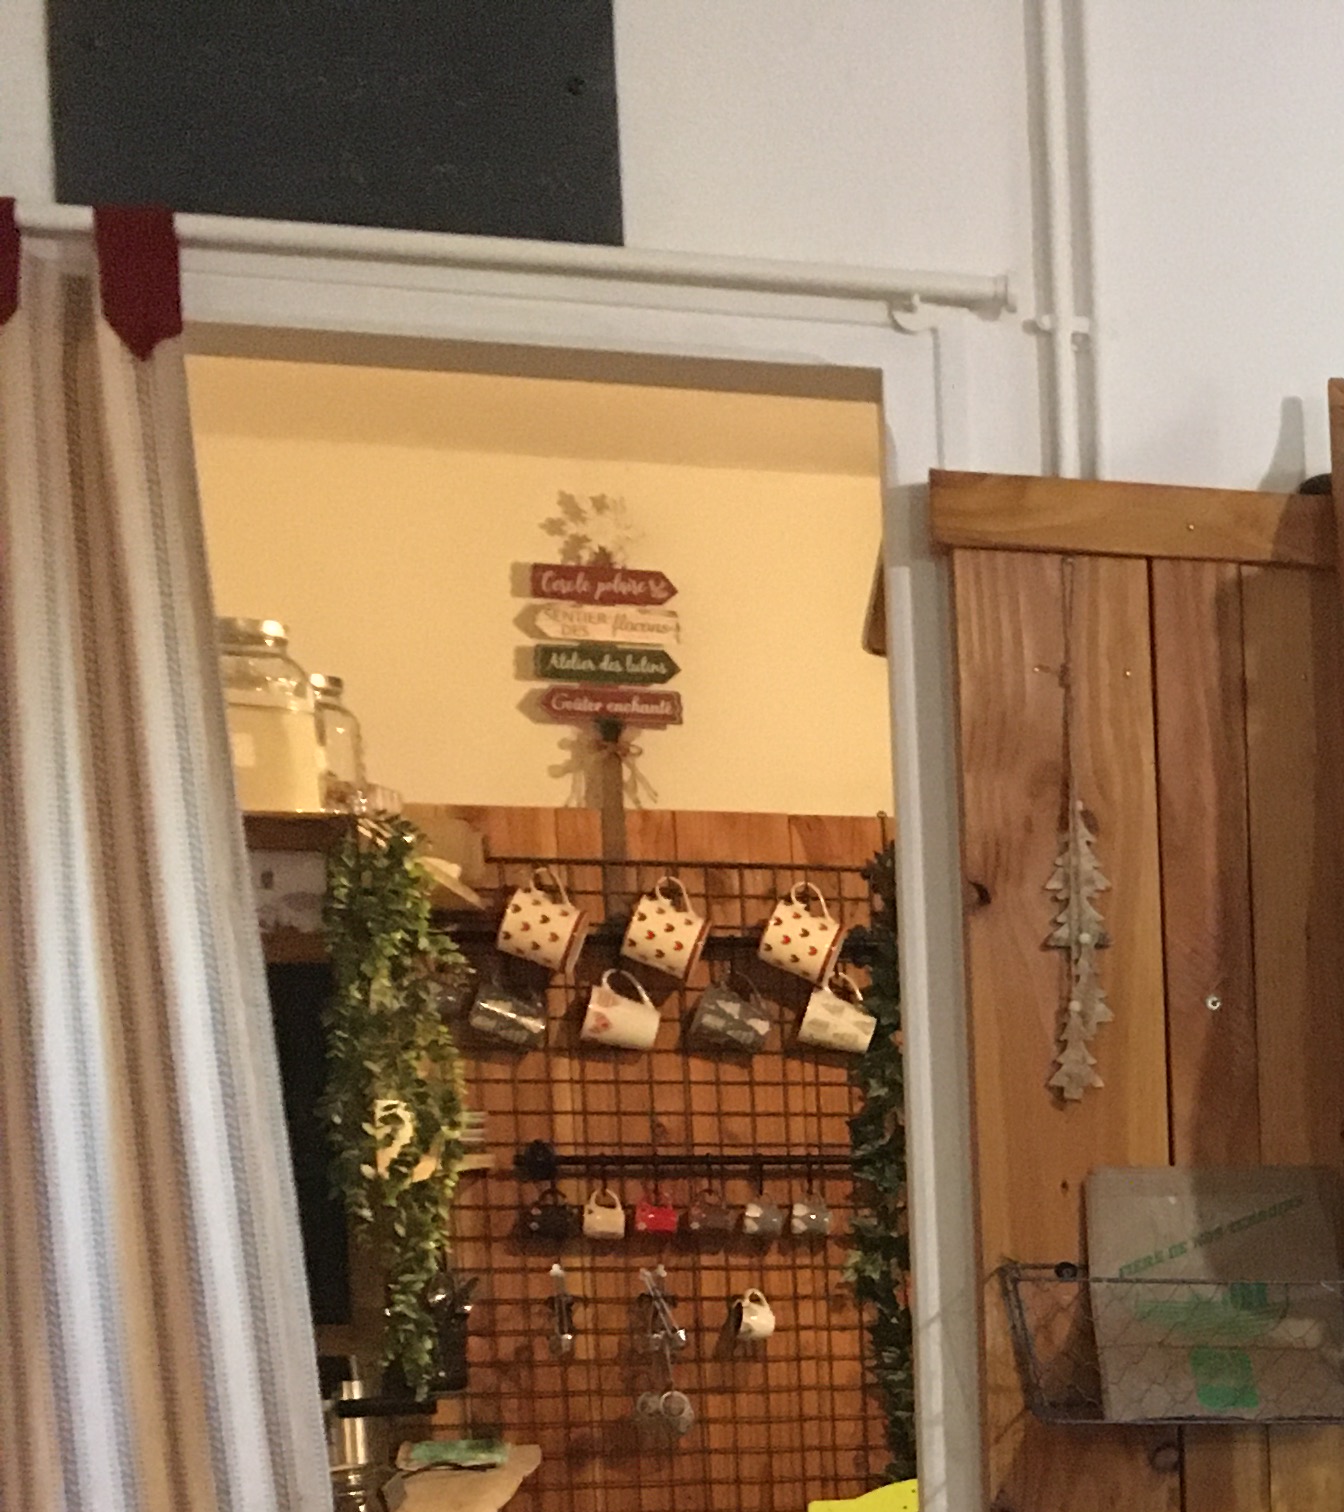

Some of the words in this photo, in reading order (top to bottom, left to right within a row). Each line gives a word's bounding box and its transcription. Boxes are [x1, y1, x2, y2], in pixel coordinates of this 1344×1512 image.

[541, 570, 590, 594] Cercle
[594, 572, 646, 600] polaire
[544, 607, 607, 625] SENTIER
[561, 625, 588, 636] DES
[548, 652, 595, 671] Atelier
[600, 654, 622, 671] des
[626, 654, 667, 674] lutins
[606, 695, 672, 714] enchanté
